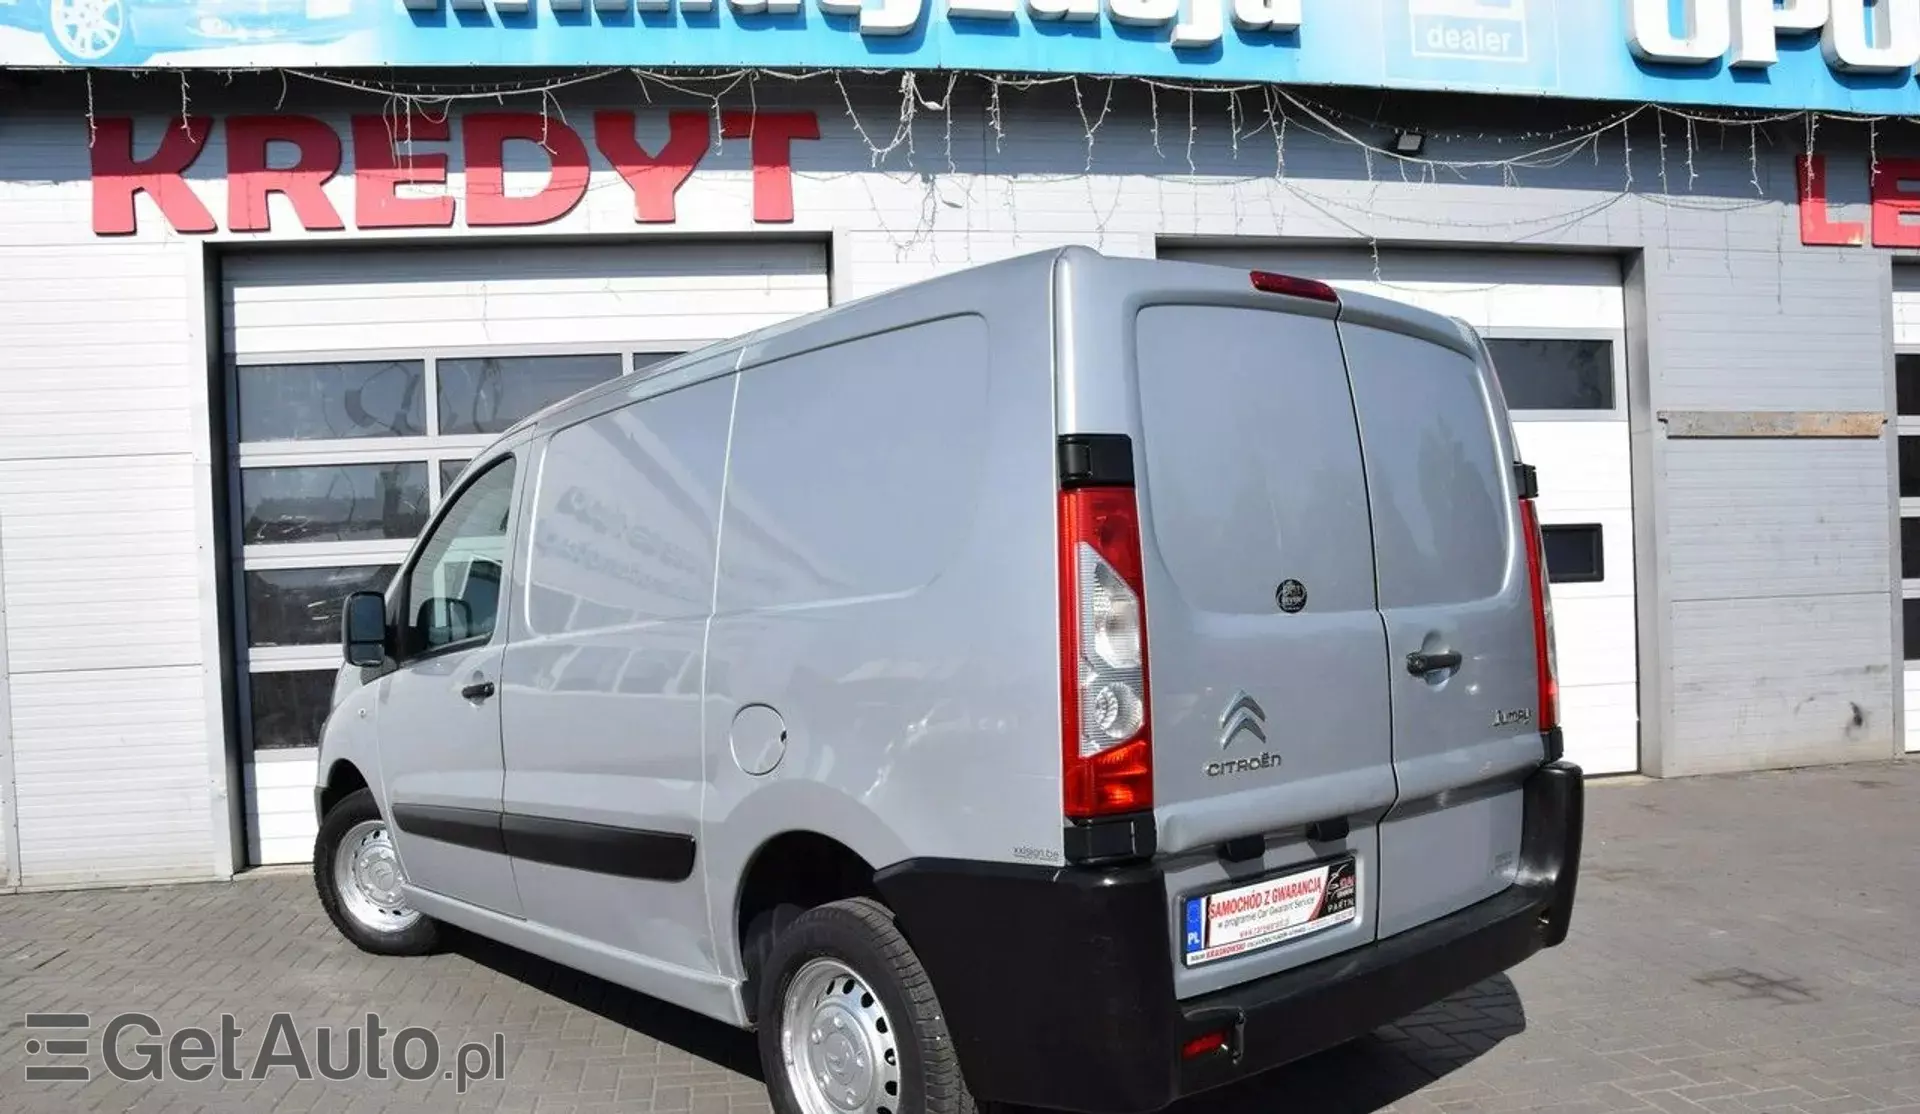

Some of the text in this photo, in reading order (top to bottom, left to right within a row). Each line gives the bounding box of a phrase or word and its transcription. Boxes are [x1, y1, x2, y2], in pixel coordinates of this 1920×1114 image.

[1426, 24, 1511, 53] dealer
[91, 111, 820, 235] KREDYT
[1208, 890, 1262, 920] SAMOCHÓD
[1264, 890, 1271, 906] Z
[1187, 931, 1200, 946] PL
